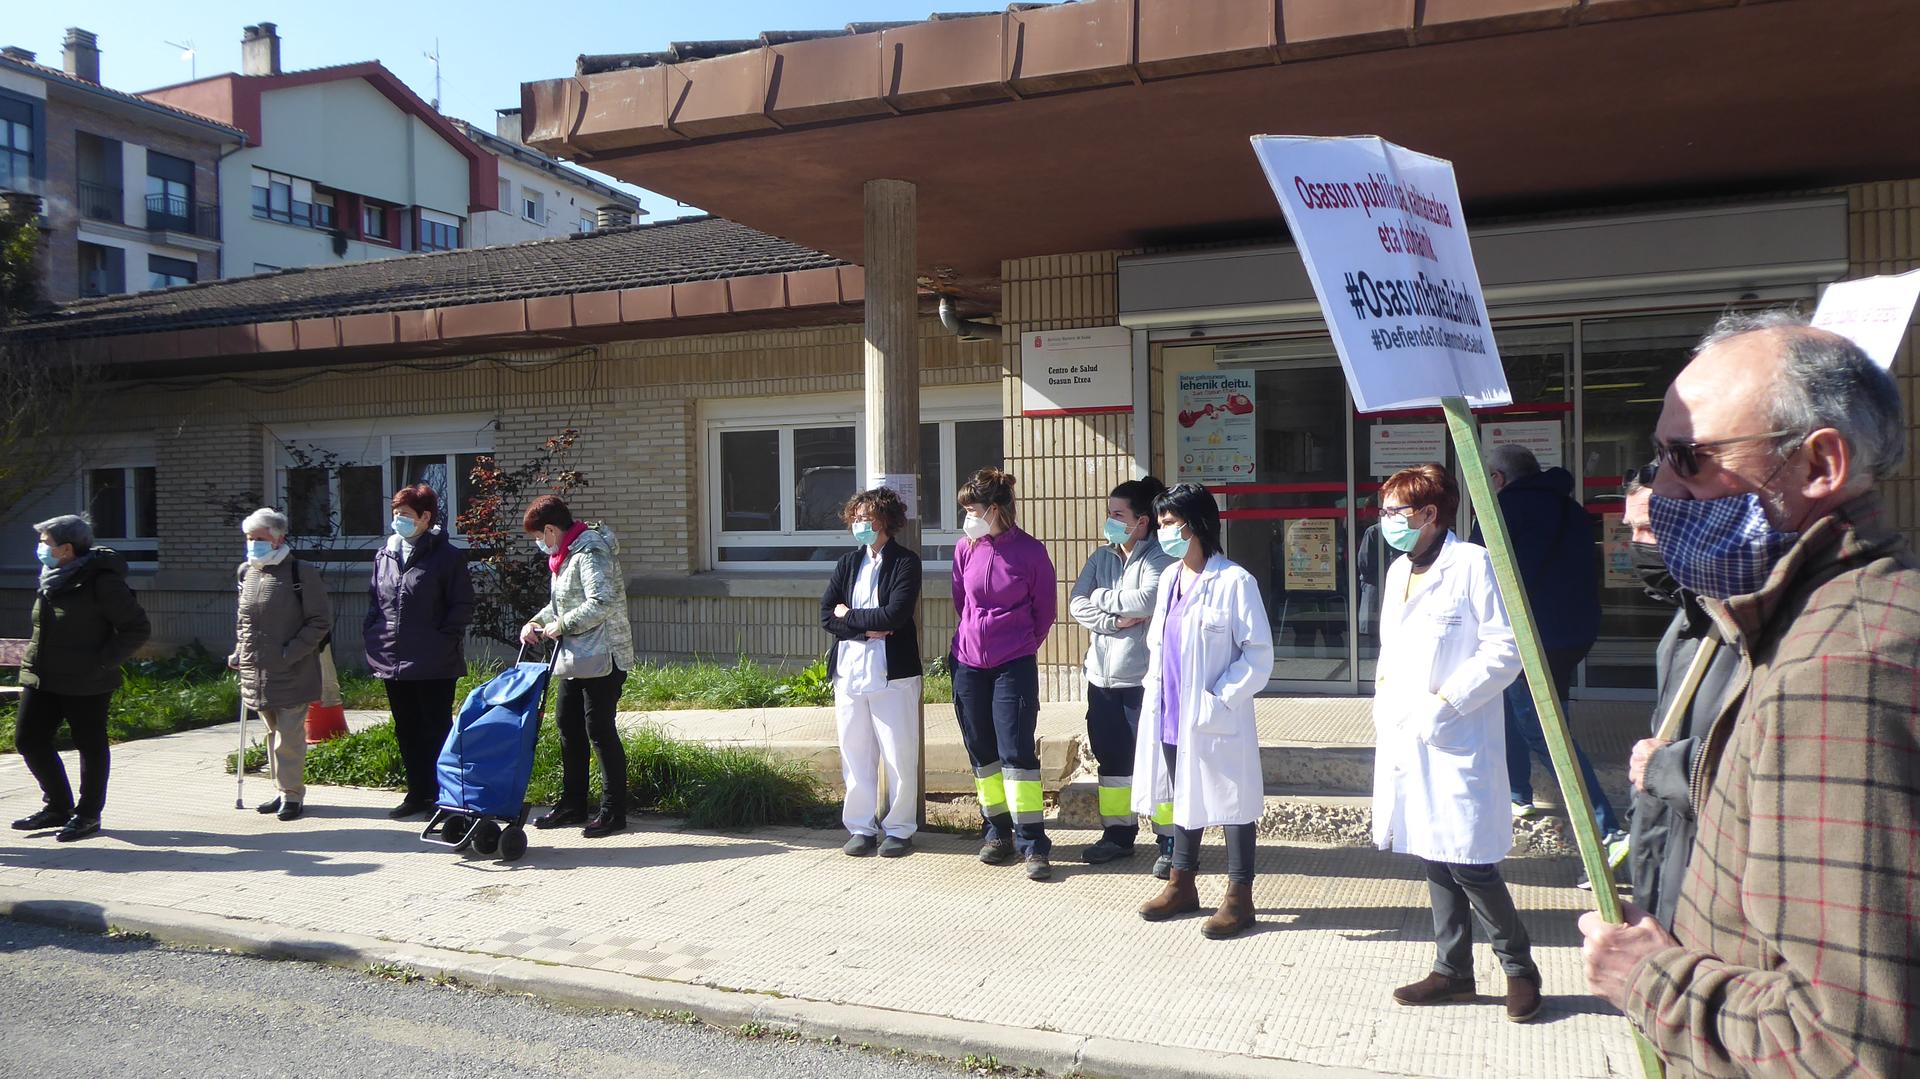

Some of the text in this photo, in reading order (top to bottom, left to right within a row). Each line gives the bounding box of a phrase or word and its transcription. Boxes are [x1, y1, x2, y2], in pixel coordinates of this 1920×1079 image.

[1294, 175, 1359, 209] Osasun
[1377, 220, 1403, 253] eta
[1048, 364, 1099, 375] Centro de Salud
[1048, 376, 1092, 385] Osasun Etxea
[1180, 379, 1252, 391] lehenik deitu.
